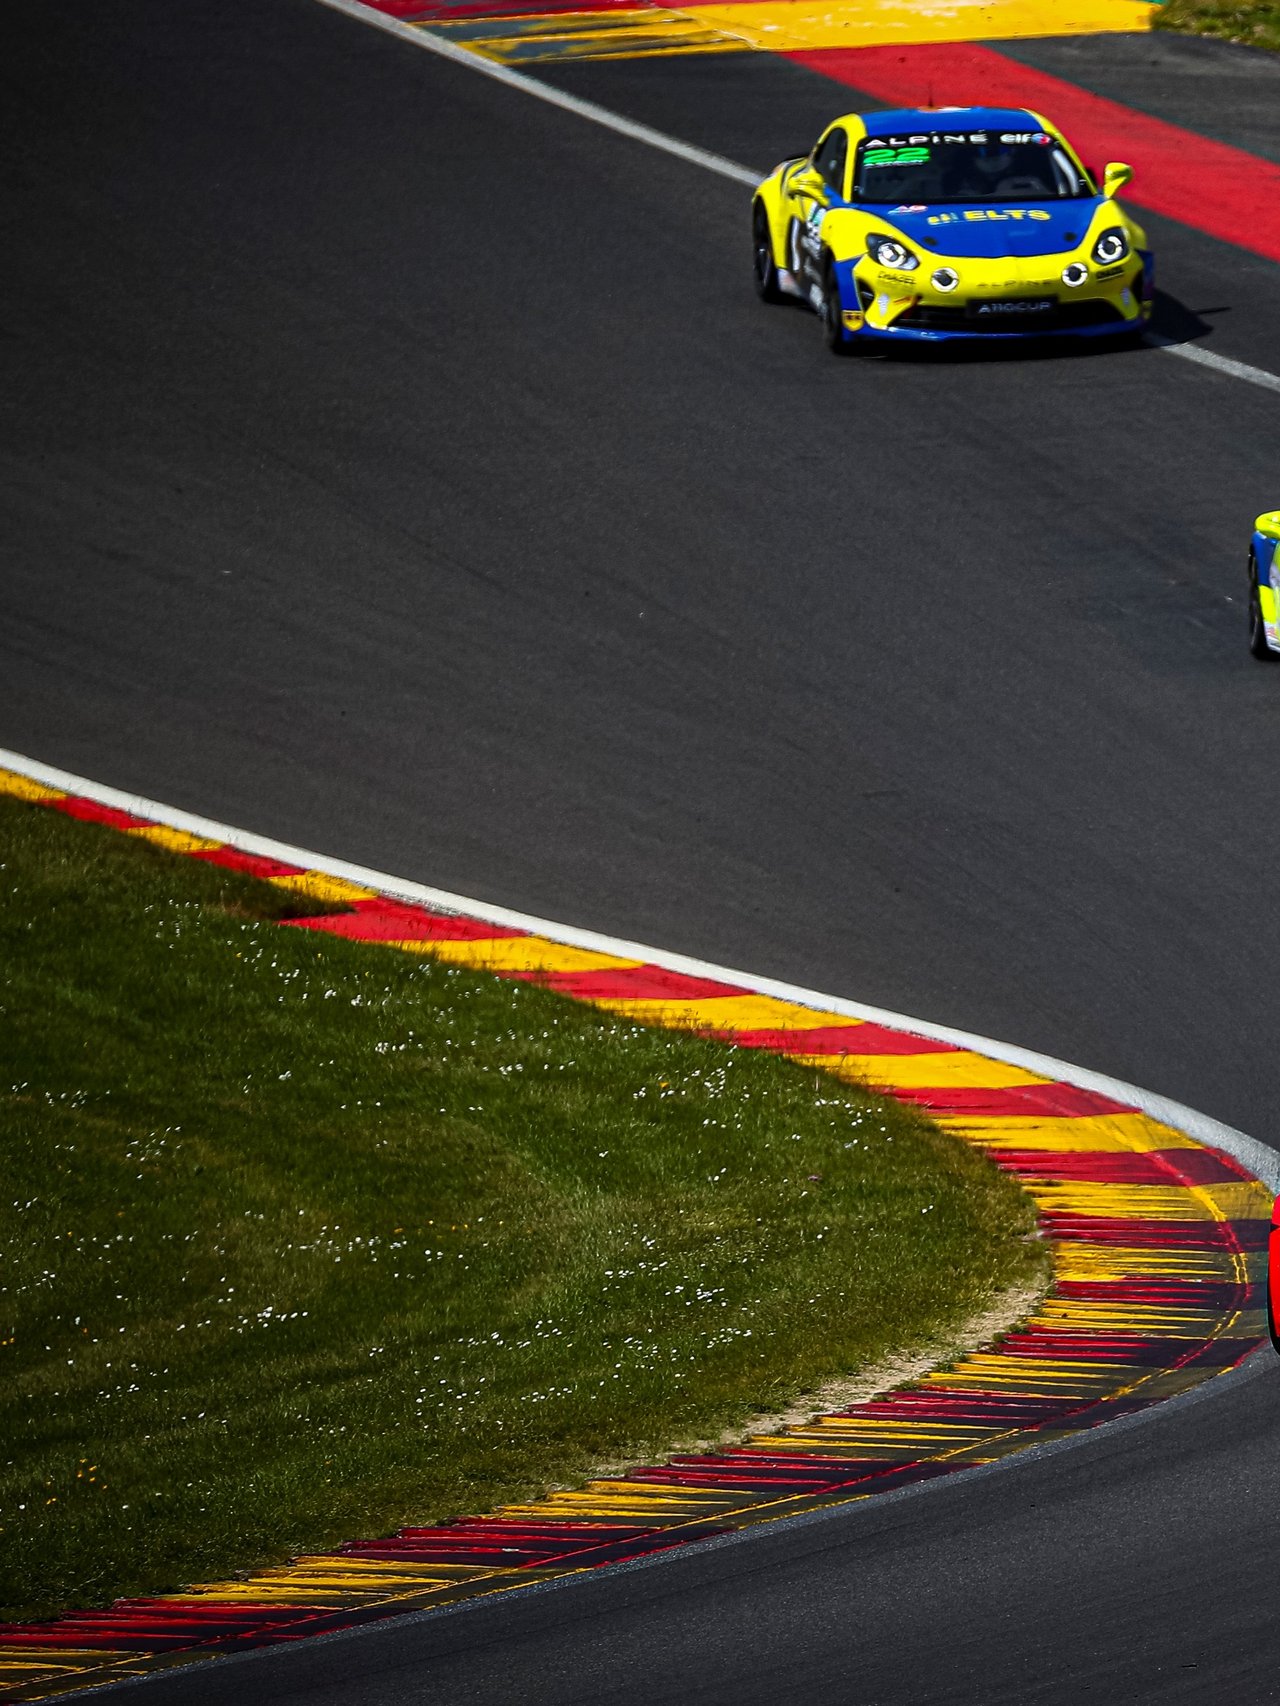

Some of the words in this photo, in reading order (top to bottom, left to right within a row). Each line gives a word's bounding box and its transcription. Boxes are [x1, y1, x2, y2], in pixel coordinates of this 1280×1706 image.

[865, 132, 988, 148] ALPINE
[1000, 133, 1033, 144] elf
[863, 147, 931, 165] 22
[963, 209, 1052, 221] ELTS
[978, 302, 1051, 314] A110CUP
